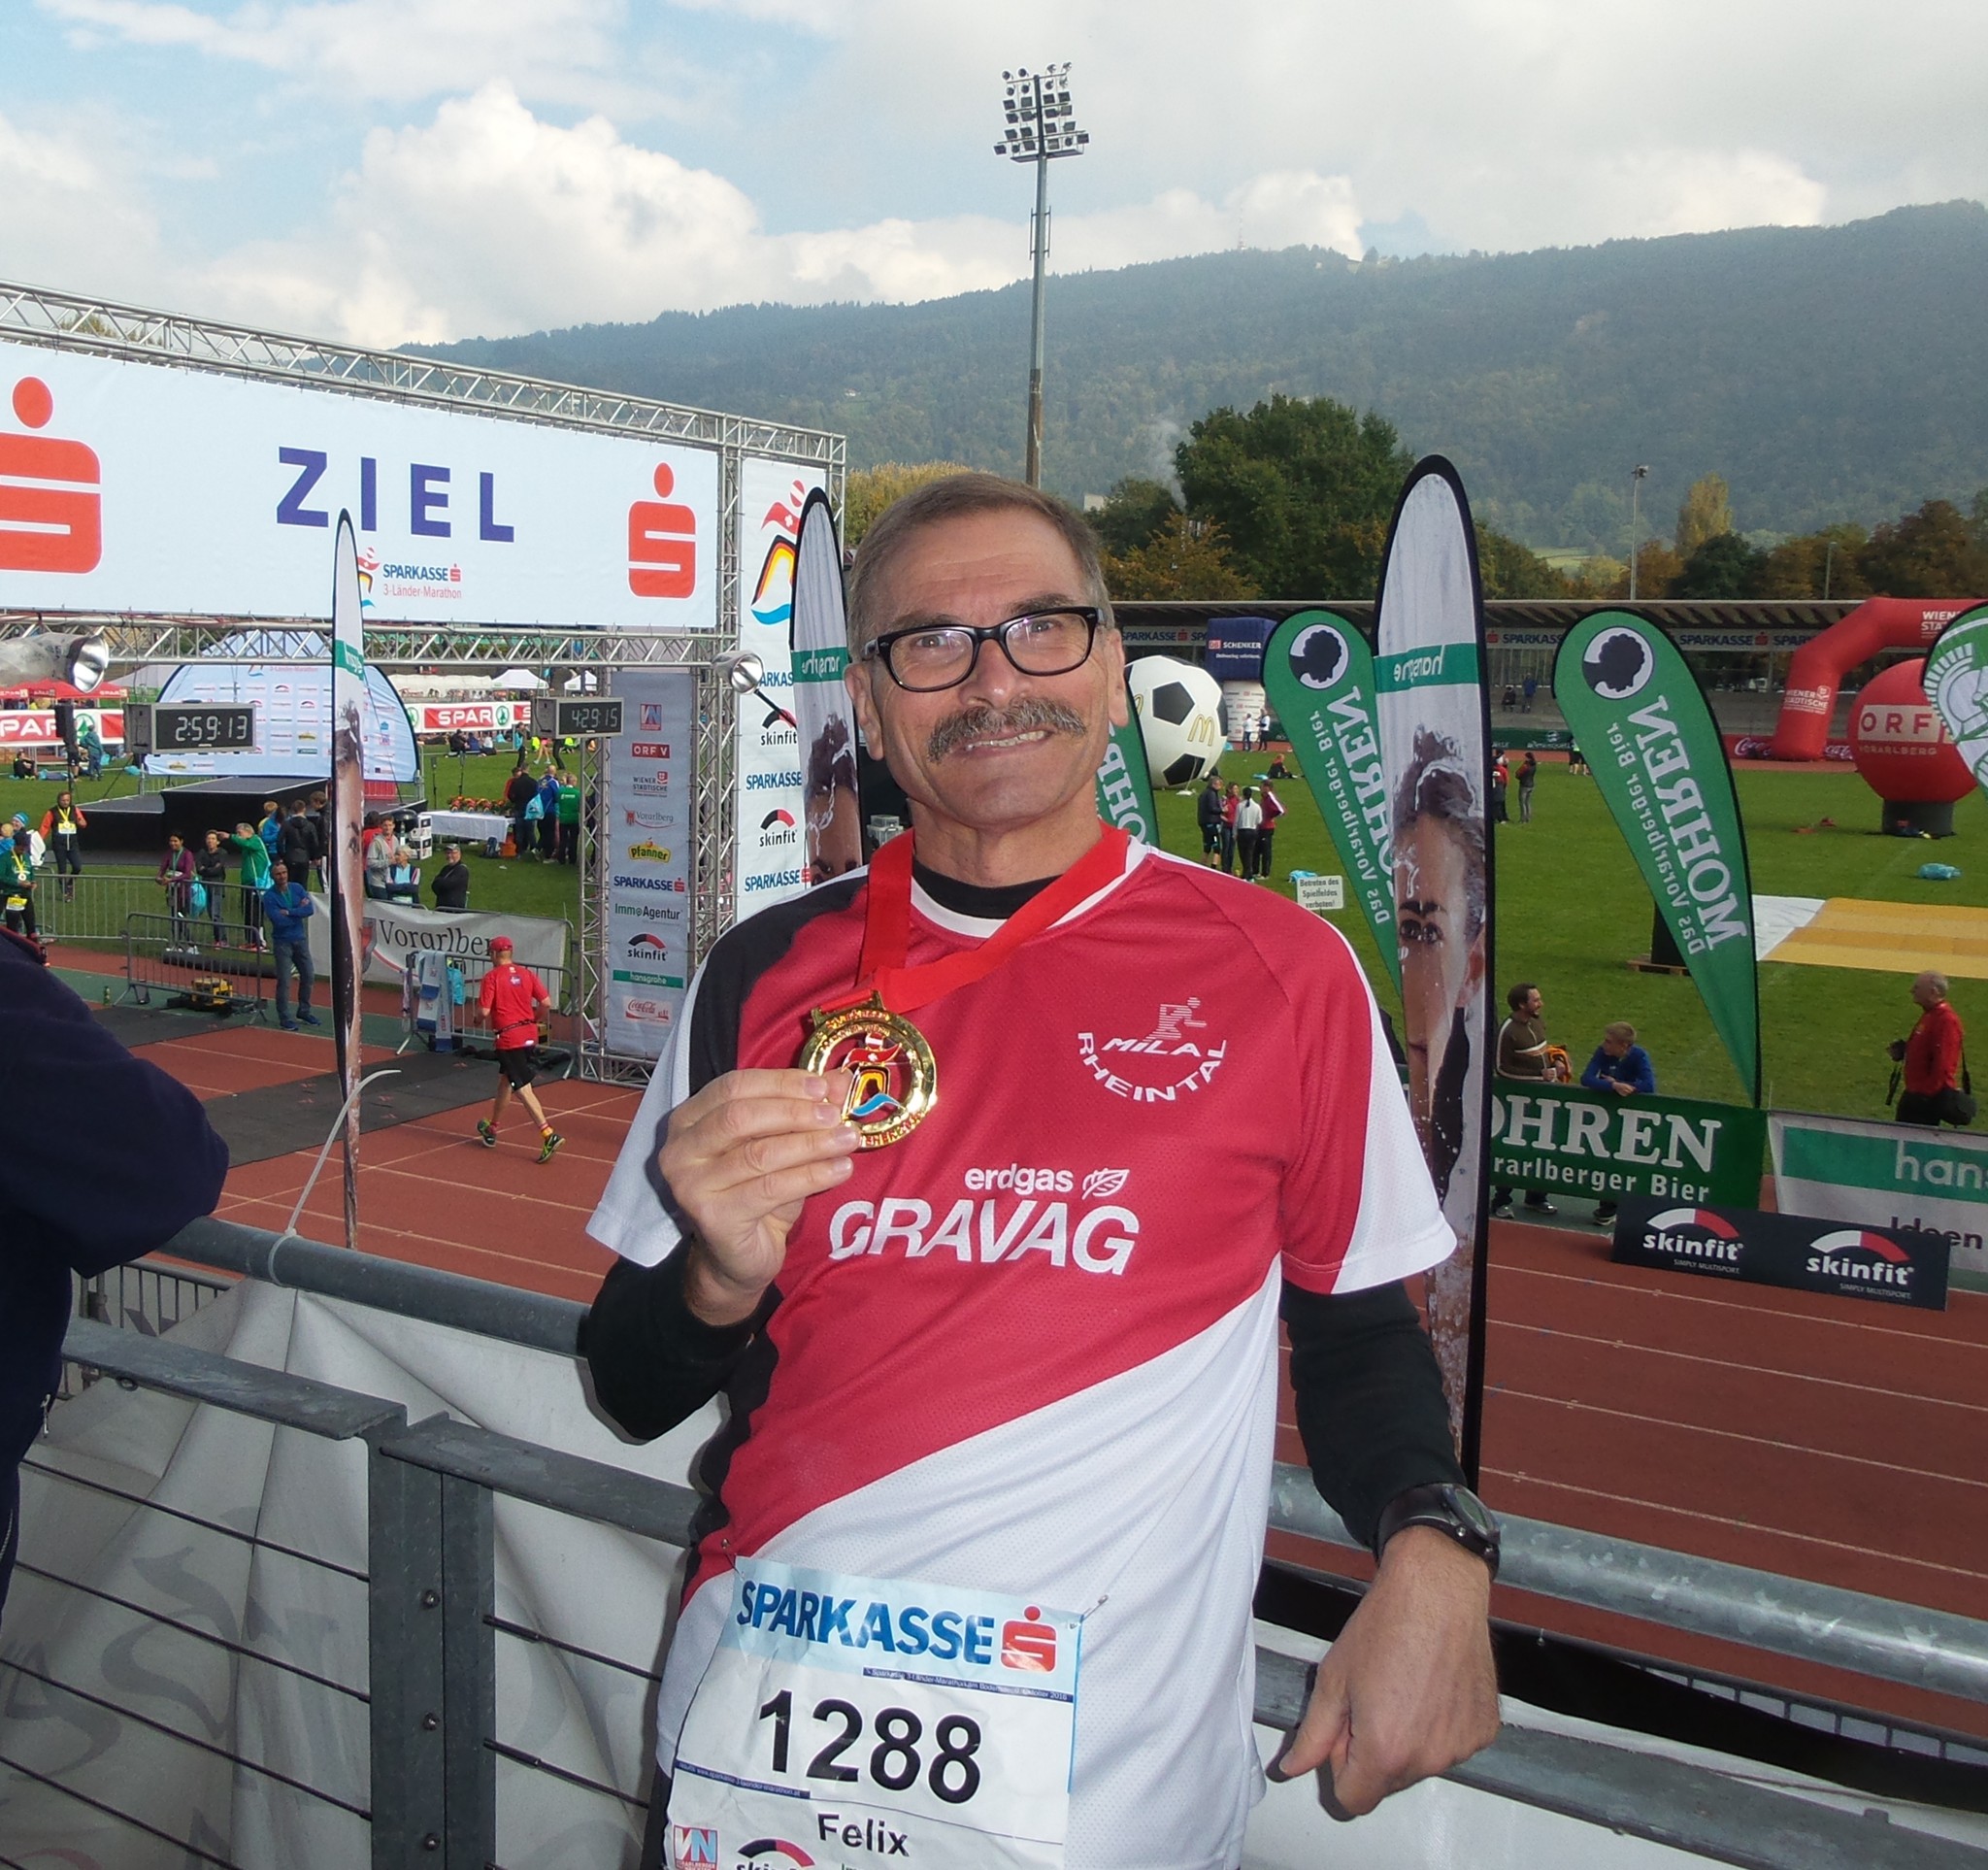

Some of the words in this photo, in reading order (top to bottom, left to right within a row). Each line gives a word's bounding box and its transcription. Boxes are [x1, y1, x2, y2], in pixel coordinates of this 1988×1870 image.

[277, 447, 514, 543] ZIEL
[382, 563, 448, 583] SPARKASSE
[382, 584, 462, 598] 3-Länder-Marathon
[1922, 611, 1961, 620] WIEN
[1679, 634, 1753, 646] SPARKASSE
[759, 671, 794, 687] ARKAS
[438, 707, 492, 725] SPAR
[1860, 712, 1933, 735] ORF
[175, 716, 248, 742] 2:59:13
[760, 731, 797, 747] skinfit
[633, 745, 656, 755] ORF
[660, 747, 668, 756] V
[746, 771, 803, 790] SPARKASSE
[636, 812, 674, 823] Vorarlberg
[759, 831, 797, 847] skinfit
[631, 846, 668, 860] pfanner
[613, 876, 673, 891] SPARKASSE
[745, 869, 801, 892] SPARKASSE
[1299, 879, 1326, 887] Betreten
[1327, 878, 1340, 886] des
[380, 919, 493, 956] Vorarlber
[627, 948, 667, 961] skinfit
[630, 971, 668, 985] hansgrohe
[1077, 1032, 1227, 1102] RHEINTAL
[964, 1163, 1075, 1195] erdgas
[1650, 1173, 1710, 1203] Bier
[828, 1197, 1140, 1276] GRAVAG
[1642, 1233, 1740, 1261] skinfit
[1673, 1258, 1697, 1268] SIMPLY
[1806, 1255, 1909, 1286] skinfit
[1839, 1282, 1866, 1292] SIMPLY
[735, 1580, 996, 1666] SPARKASSE
[758, 1688, 982, 1805] 1288
[817, 1813, 910, 1857] Felix
